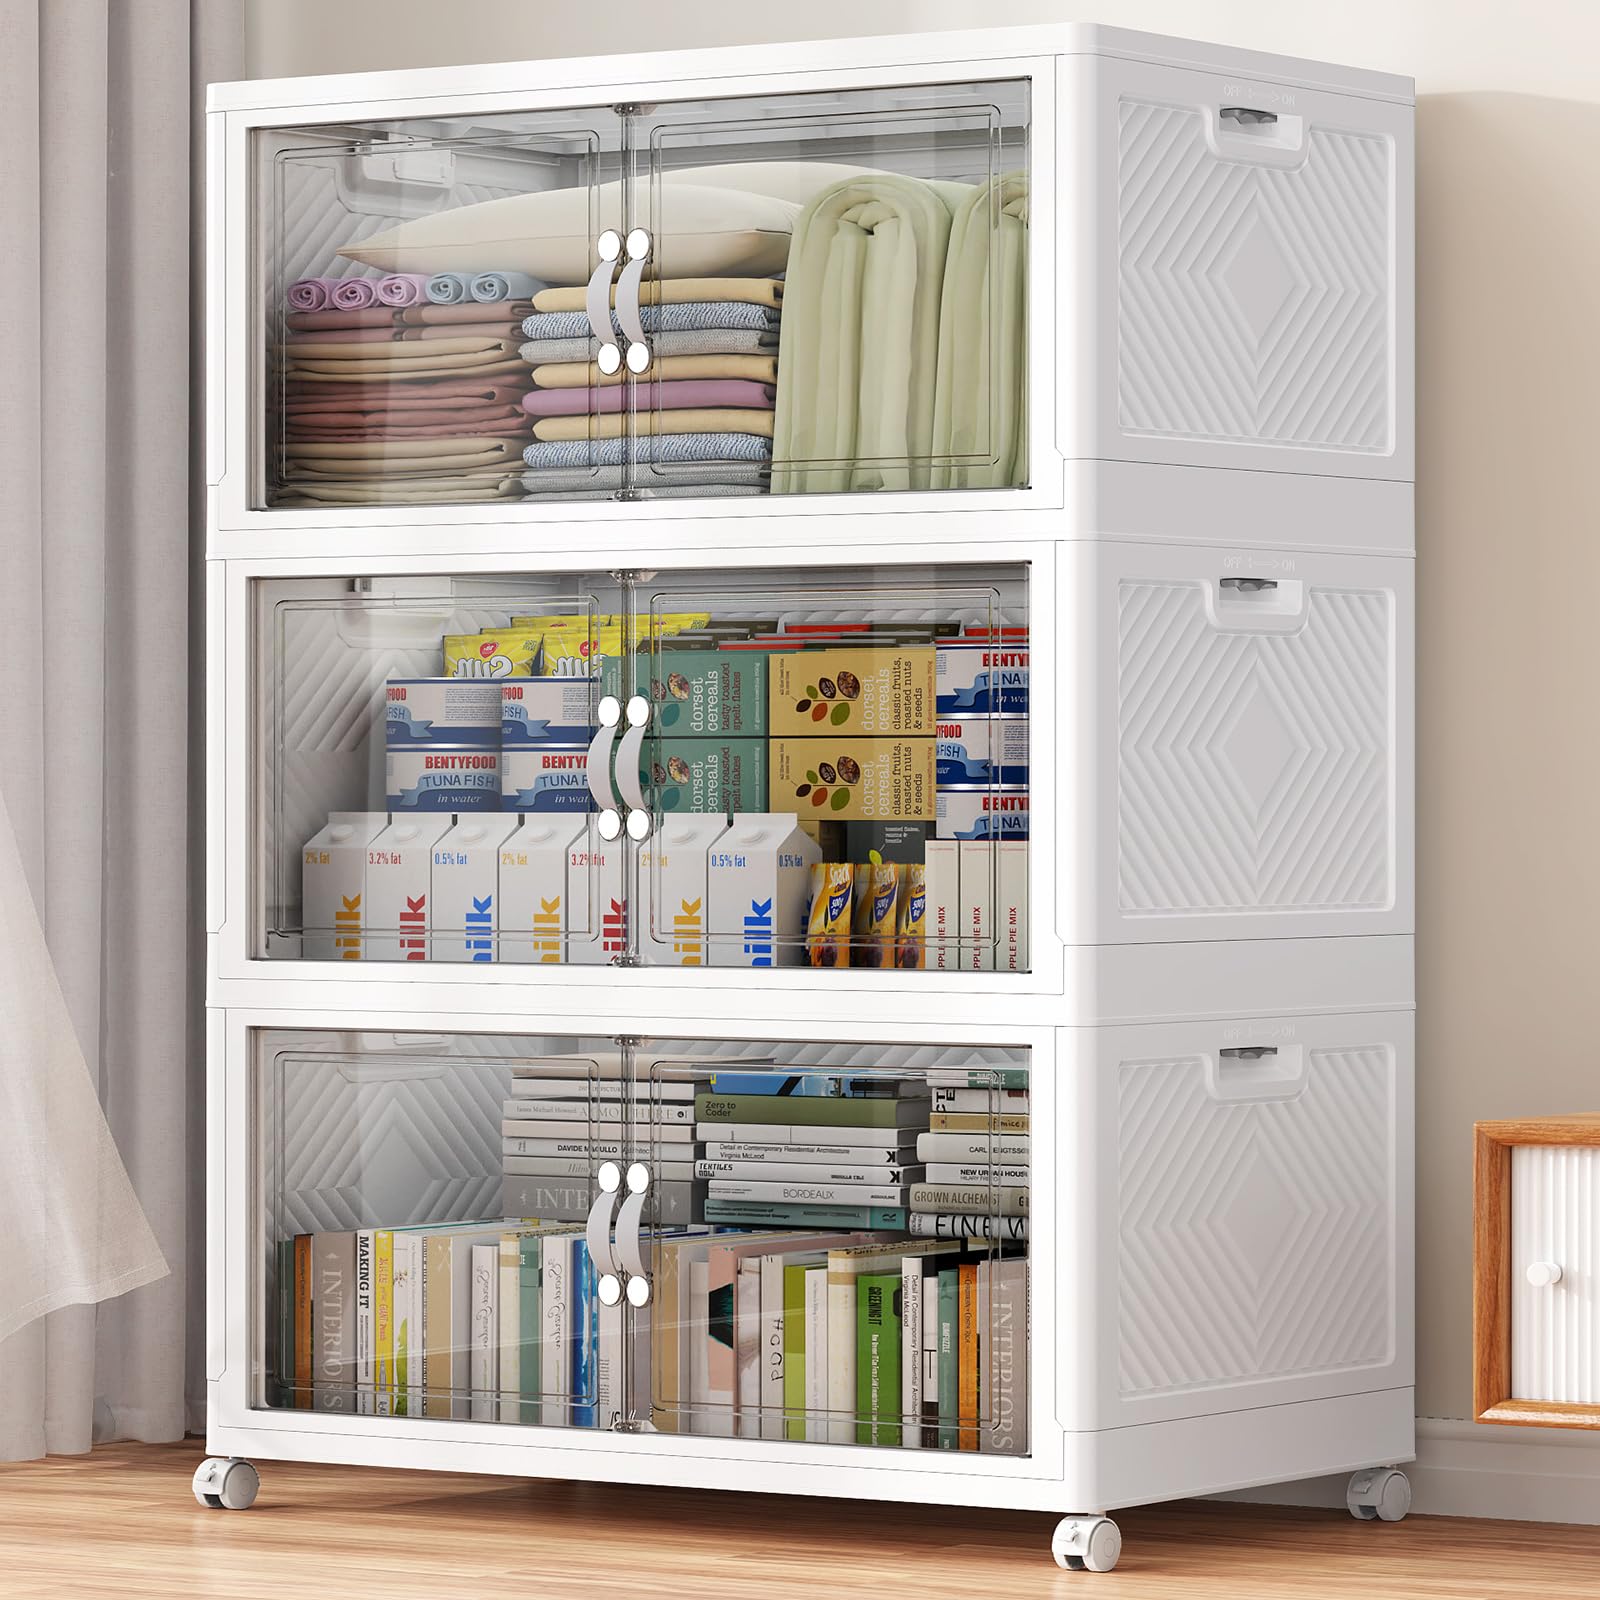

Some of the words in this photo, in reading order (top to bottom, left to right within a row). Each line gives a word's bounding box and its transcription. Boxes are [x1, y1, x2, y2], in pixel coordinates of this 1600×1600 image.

[892, 657, 902, 690] fruits,
[903, 660, 912, 686] nuts
[690, 677, 704, 732] dorset
[705, 670, 719, 732] cereals
[861, 675, 875, 731] dorset
[876, 669, 890, 731] cereals
[903, 689, 912, 730] roasted
[914, 687, 923, 718] seeds
[892, 692, 901, 730] classic
[914, 720, 923, 730] &
[425, 755, 497, 769] BENTYFOOD
[892, 743, 902, 776] fruits,
[903, 746, 912, 772] nuts
[423, 774, 460, 788] TUNA
[464, 774, 495, 788] FISH
[540, 774, 579, 788] TUNA
[690, 761, 704, 814] dorset
[705, 754, 719, 814] cereals
[861, 760, 875, 816] dorset
[876, 754, 890, 816] cereals
[914, 773, 923, 804] seeds
[437, 794, 448, 803] in
[451, 794, 482, 804] water
[555, 794, 565, 803] in
[892, 778, 901, 816] classic
[903, 774, 912, 816] roasted
[914, 806, 923, 816] &
[305, 852, 318, 865] 2%
[319, 852, 331, 865] fat
[369, 852, 389, 865] 3.2%
[390, 852, 402, 865] fat
[434, 852, 455, 865] 0.5%
[456, 852, 468, 865] fat
[502, 853, 515, 866] 2%
[517, 853, 528, 866] fat
[711, 854, 733, 867] 0.5%
[734, 854, 746, 868] fat
[779, 855, 794, 868] 0.5%
[795, 856, 803, 868] fat
[973, 907, 981, 924] MIX
[1009, 907, 1017, 925] MIX
[1009, 928, 1017, 943] PIE
[705, 1101, 725, 1109] Zero
[705, 1108, 731, 1117] Coder
[557, 1144, 583, 1152] DAVIDE
[699, 1163, 733, 1171] TEXTILES
[783, 1188, 834, 1200] BORDEAUX
[914, 1191, 949, 1204] GROWN
[359, 1236, 369, 1291] MAKING
[902, 1275, 910, 1299] Virginia
[911, 1275, 919, 1294] Detail
[359, 1295, 369, 1309] IT
[910, 1302, 918, 1348] Contemporary
[322, 1269, 343, 1409] INTERIORS
[911, 1350, 919, 1386] Residential
[992, 1302, 1014, 1450] INTERIORS
